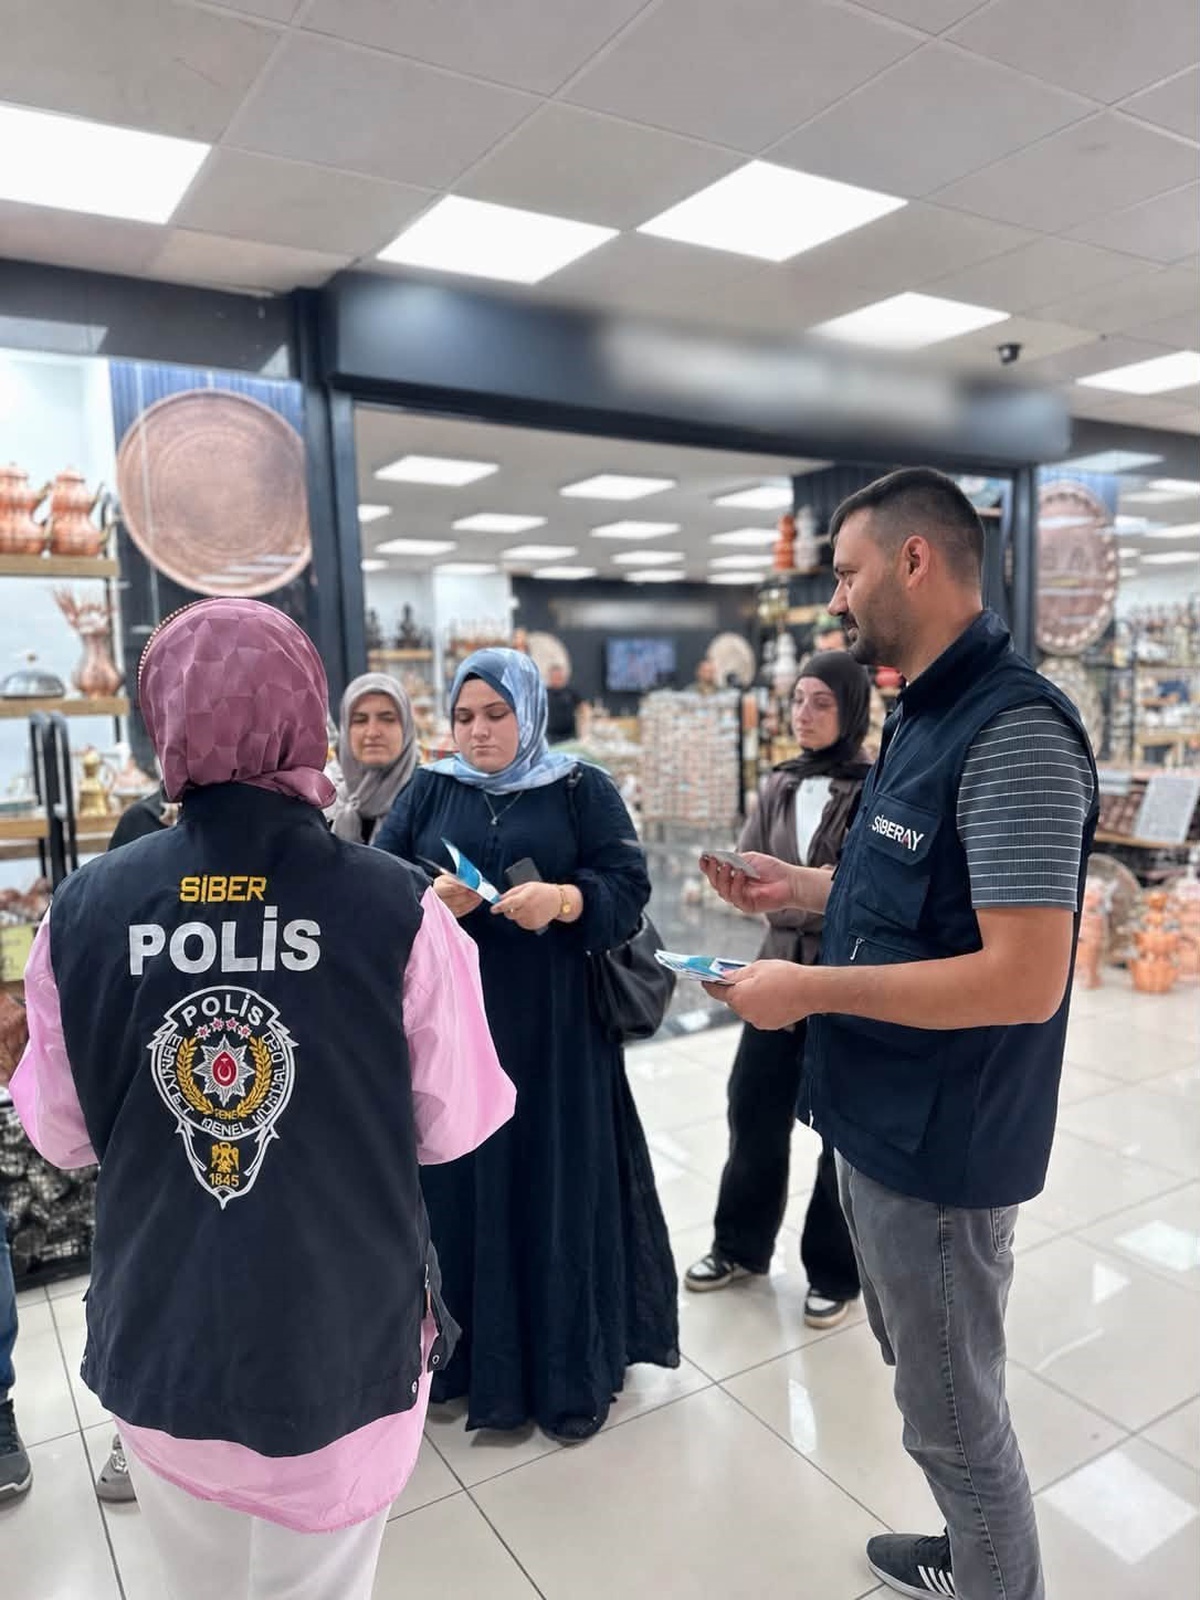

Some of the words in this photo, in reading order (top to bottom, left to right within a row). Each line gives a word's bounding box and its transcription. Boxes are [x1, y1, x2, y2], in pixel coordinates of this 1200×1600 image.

[129, 905, 321, 976] POLİS
[181, 994, 264, 1027] POLİS
[208, 1172, 240, 1187] 1845
